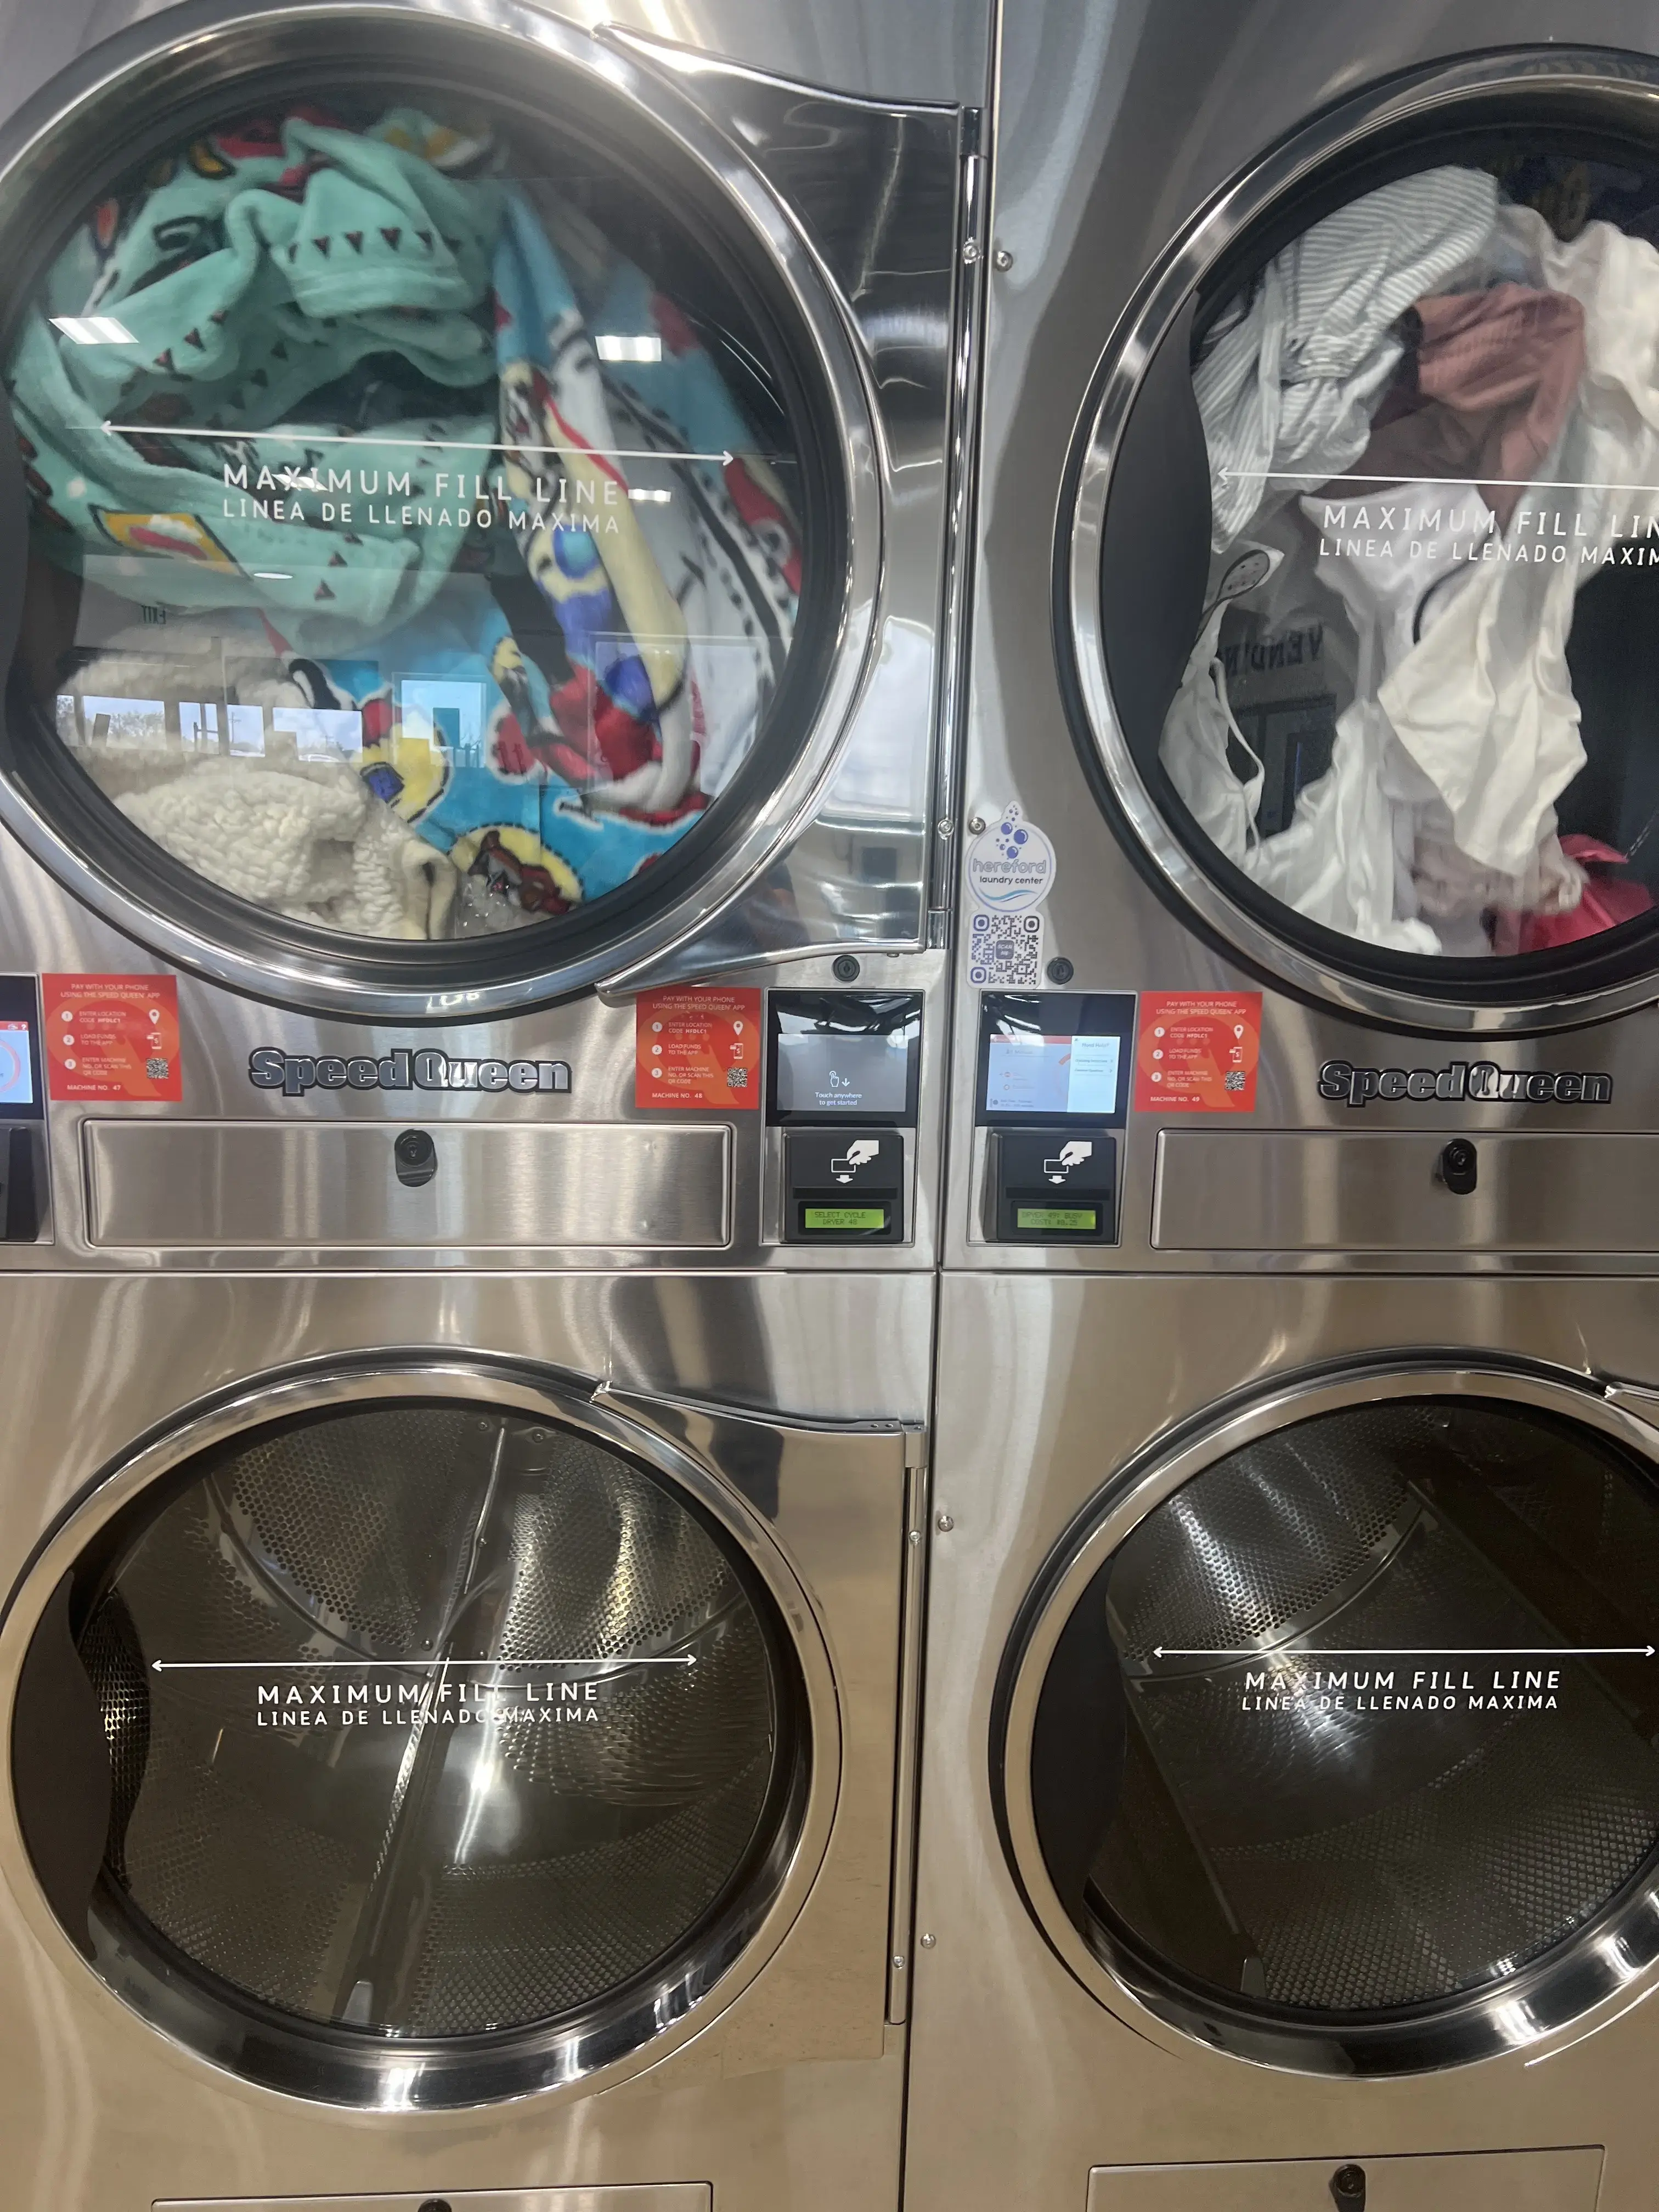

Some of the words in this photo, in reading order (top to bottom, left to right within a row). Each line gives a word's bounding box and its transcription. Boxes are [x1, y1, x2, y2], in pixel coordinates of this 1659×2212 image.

[223, 464, 411, 496] MAXIMUM
[436, 472, 511, 502] FILL
[536, 478, 618, 505] LINE
[223, 499, 304, 521] LINEA
[322, 503, 352, 523] DE
[369, 505, 492, 528] LLENADO
[509, 511, 619, 534] MAXIMA
[1323, 505, 1495, 534] MAXIMUM
[1517, 511, 1587, 537] FILL
[1319, 538, 1393, 557] LINEA
[1410, 540, 1436, 559] DE
[1452, 542, 1566, 563] LLENADO
[973, 859, 1046, 874] hereford
[980, 876, 1012, 885] laundry
[1245, 1671, 1394, 1690] MAXIMUM
[1412, 1671, 1474, 1689] FILL
[1493, 1671, 1560, 1689] LINE
[258, 1685, 419, 1704] MAXIMUM
[440, 1684, 505, 1702] FILL
[526, 1682, 598, 1700] LINE
[1242, 1696, 1306, 1711] LINEA
[1320, 1696, 1344, 1711] DE
[1357, 1696, 1456, 1710] LLENADO
[1468, 1695, 1558, 1710] MAXIMA
[257, 1711, 328, 1726] LINEA
[342, 1710, 368, 1725] DE
[382, 1709, 488, 1724] LLENADO
[504, 1707, 599, 1723] MAXIMA
